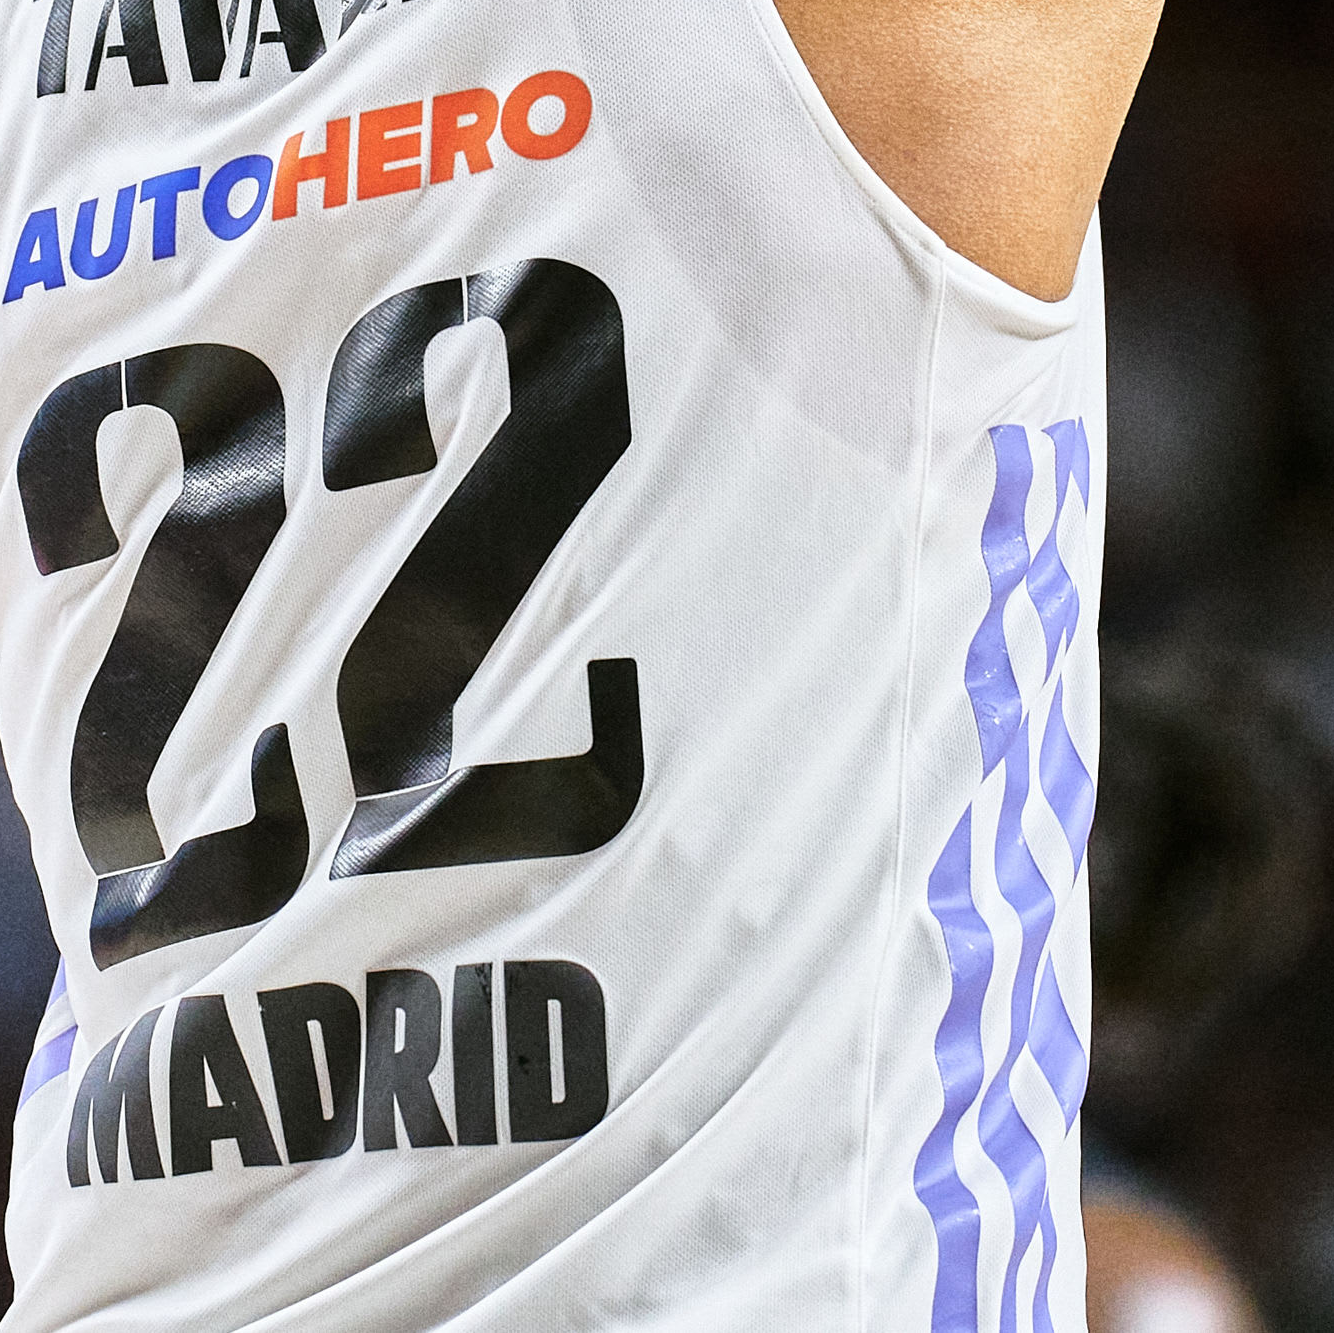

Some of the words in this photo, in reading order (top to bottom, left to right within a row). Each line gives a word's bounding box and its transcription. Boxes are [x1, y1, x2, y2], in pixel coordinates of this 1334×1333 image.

[2, 70, 592, 304] AUTOHERO
[17, 258, 644, 971] 22
[67, 959, 610, 1188] MADRID
